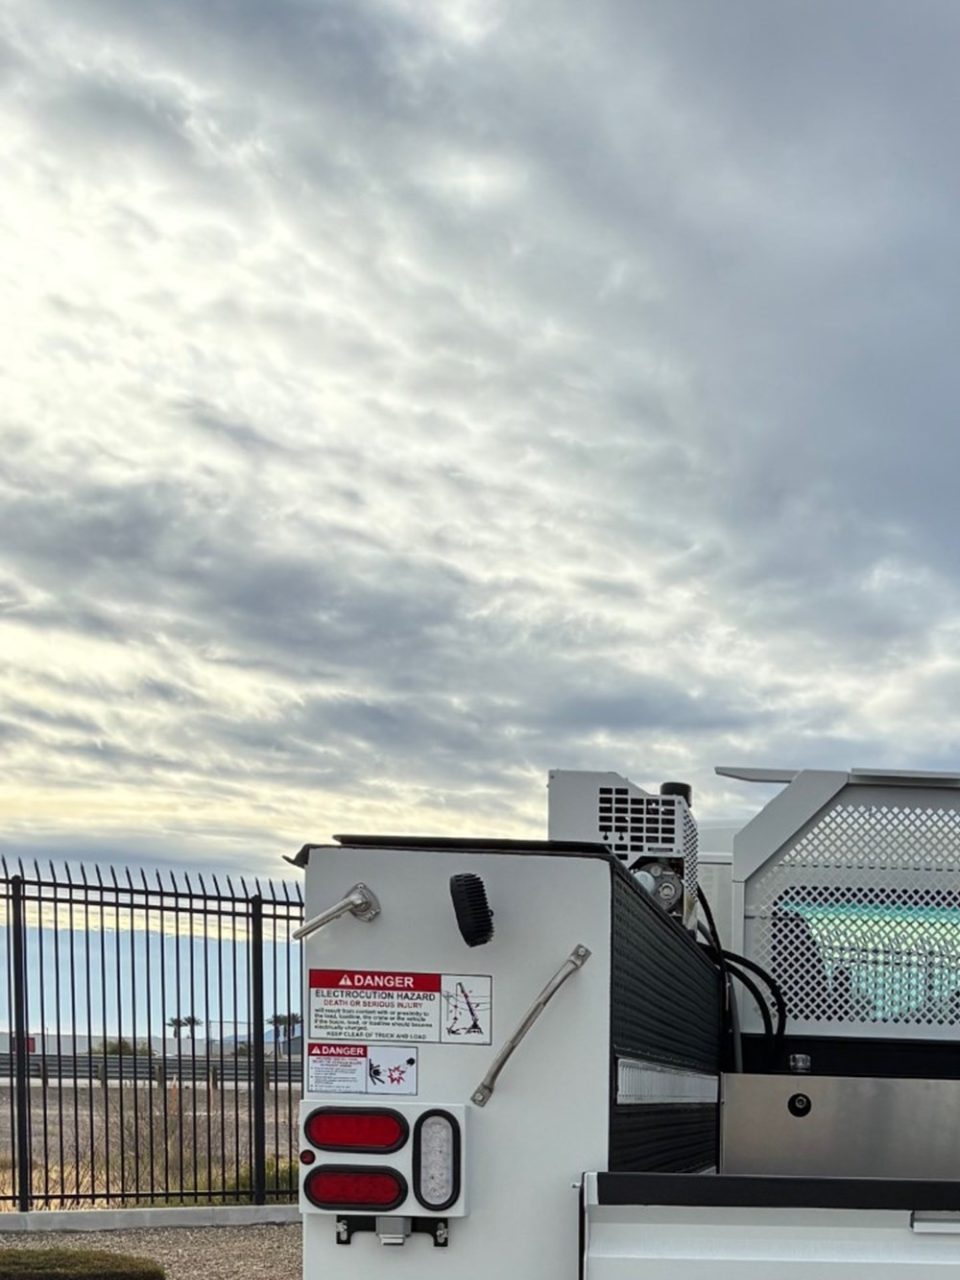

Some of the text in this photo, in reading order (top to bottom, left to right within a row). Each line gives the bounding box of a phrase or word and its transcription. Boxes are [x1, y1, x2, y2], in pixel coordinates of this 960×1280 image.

[354, 974, 414, 988] DANGER
[315, 989, 436, 1001] ELECTROCUTION HAZARD
[322, 1045, 364, 1056] DANGER
